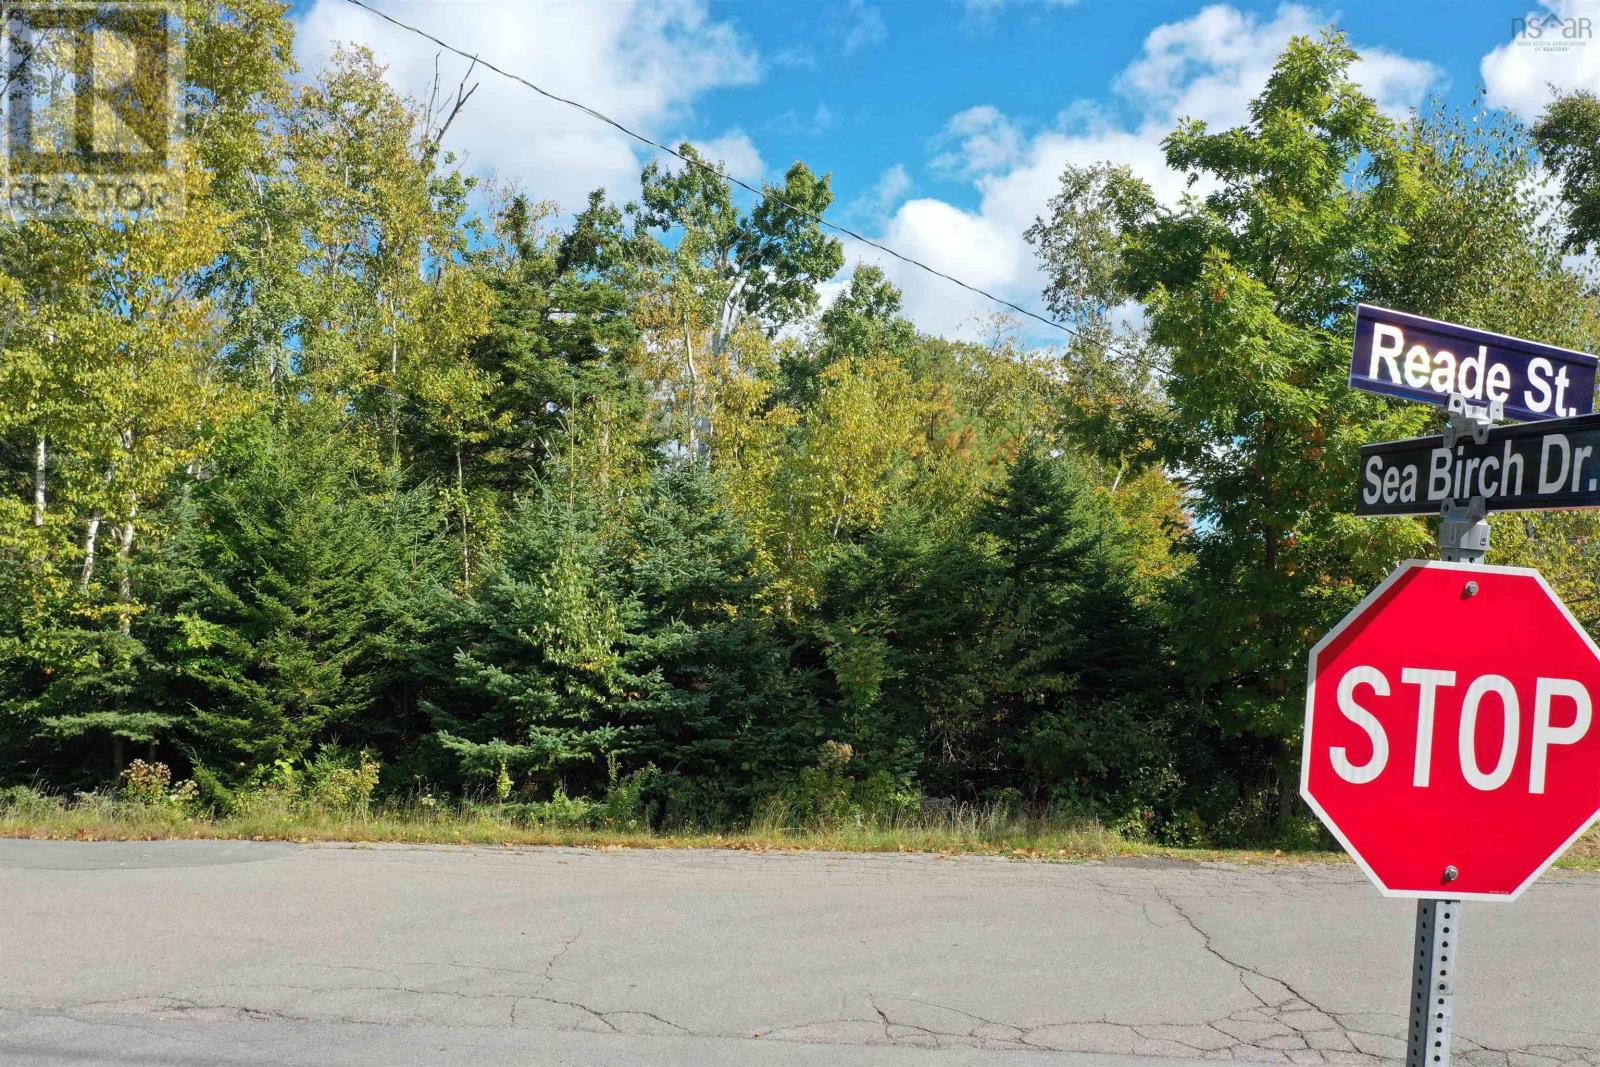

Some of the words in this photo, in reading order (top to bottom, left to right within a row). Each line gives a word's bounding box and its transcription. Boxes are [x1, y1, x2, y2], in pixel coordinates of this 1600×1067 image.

[1368, 322, 1511, 403] Reade
[1523, 357, 1577, 417] St.
[1362, 455, 1418, 505] Sea
[1427, 439, 1525, 501] Birch
[1537, 433, 1598, 495] Dr.
[1329, 665, 1593, 795] STOP
